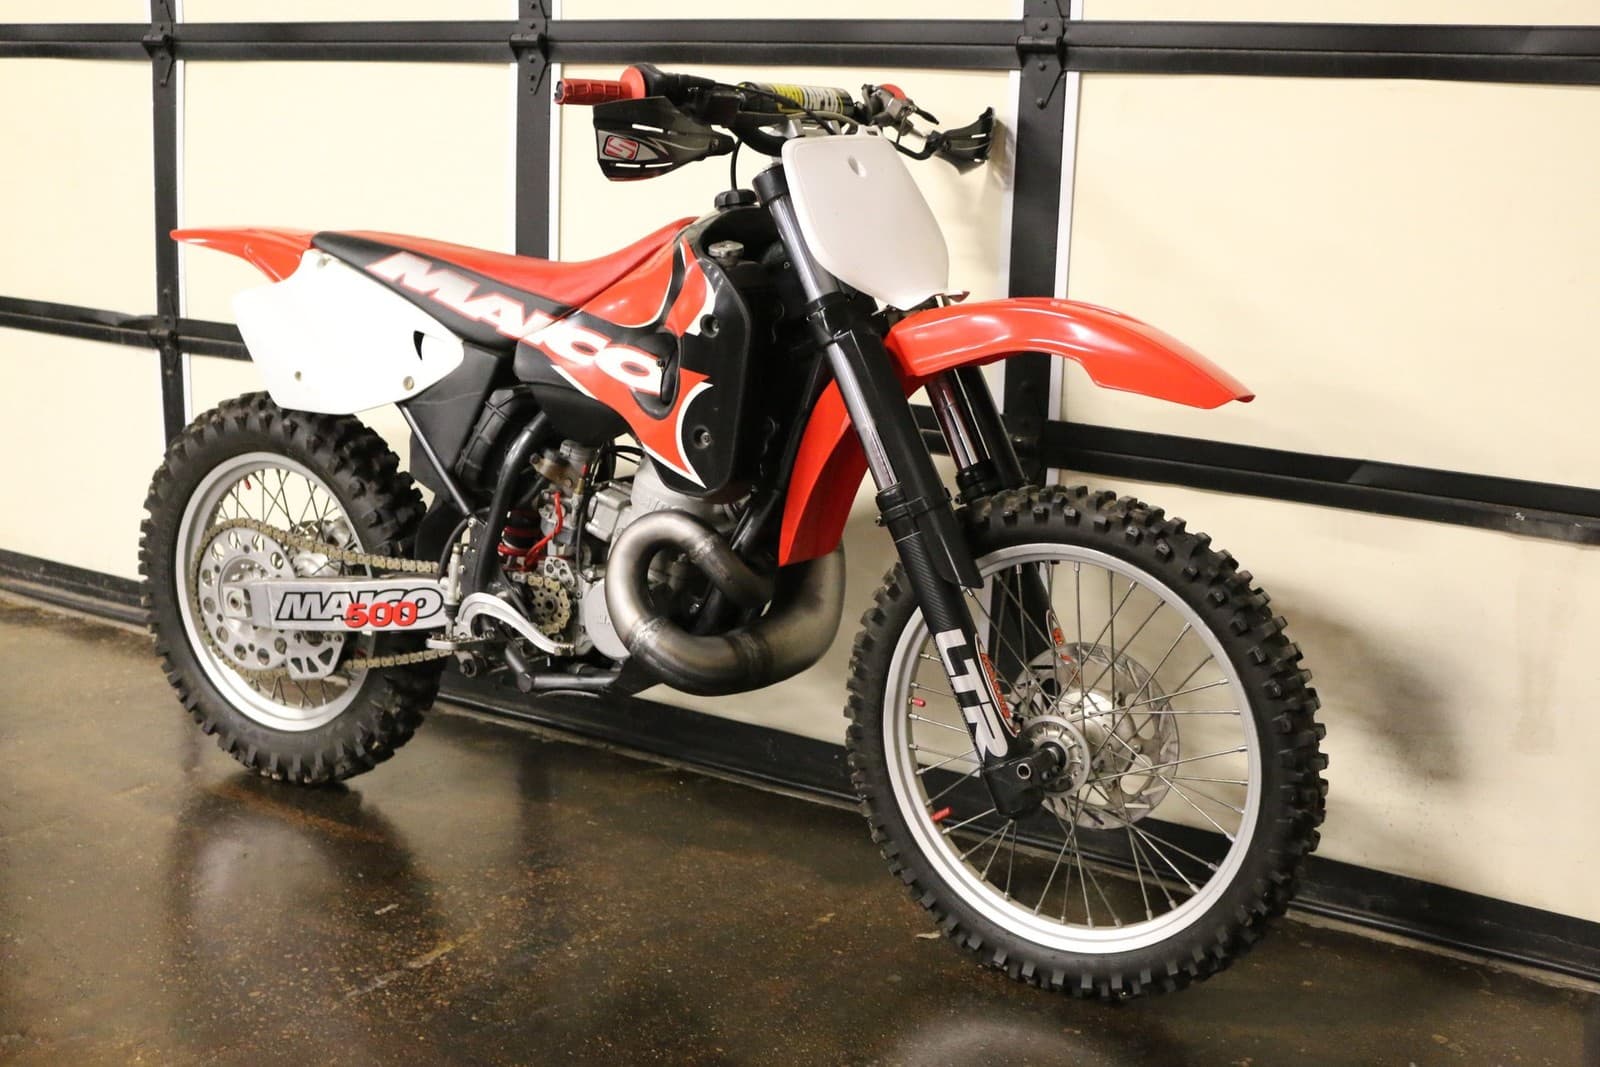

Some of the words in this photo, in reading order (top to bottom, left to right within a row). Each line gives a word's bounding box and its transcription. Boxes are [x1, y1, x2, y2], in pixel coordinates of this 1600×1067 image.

[365, 251, 664, 397] MAICO
[275, 587, 444, 622] MAICO
[344, 601, 418, 629] 500
